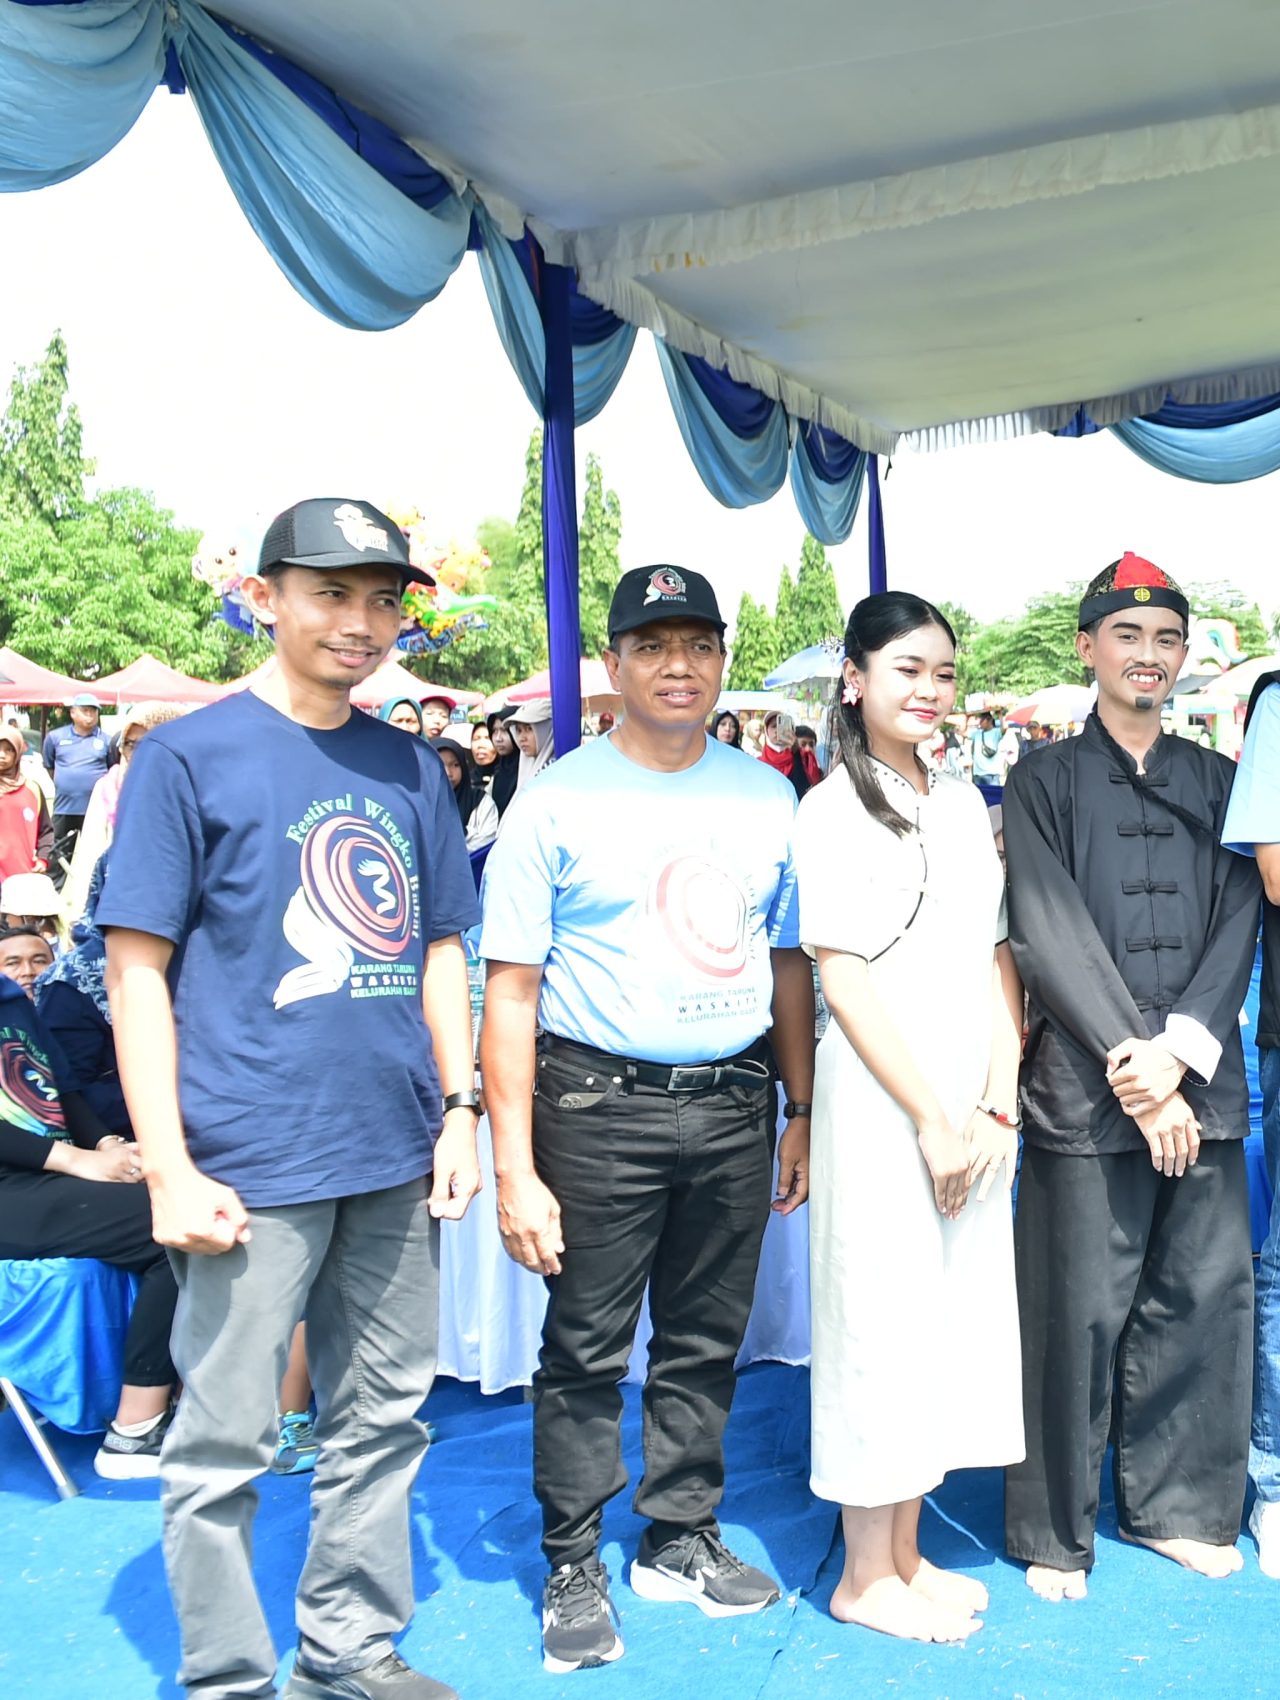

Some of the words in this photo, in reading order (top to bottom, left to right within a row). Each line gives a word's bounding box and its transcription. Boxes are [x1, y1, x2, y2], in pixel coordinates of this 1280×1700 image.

[285, 793, 353, 845] Festival
[364, 797, 413, 869] Wingko
[350, 963, 392, 975] KARANG
[350, 986, 403, 998] KELURAHAN
[680, 989, 724, 1001] KARANG
[676, 1011, 737, 1024] KELURAHAN
